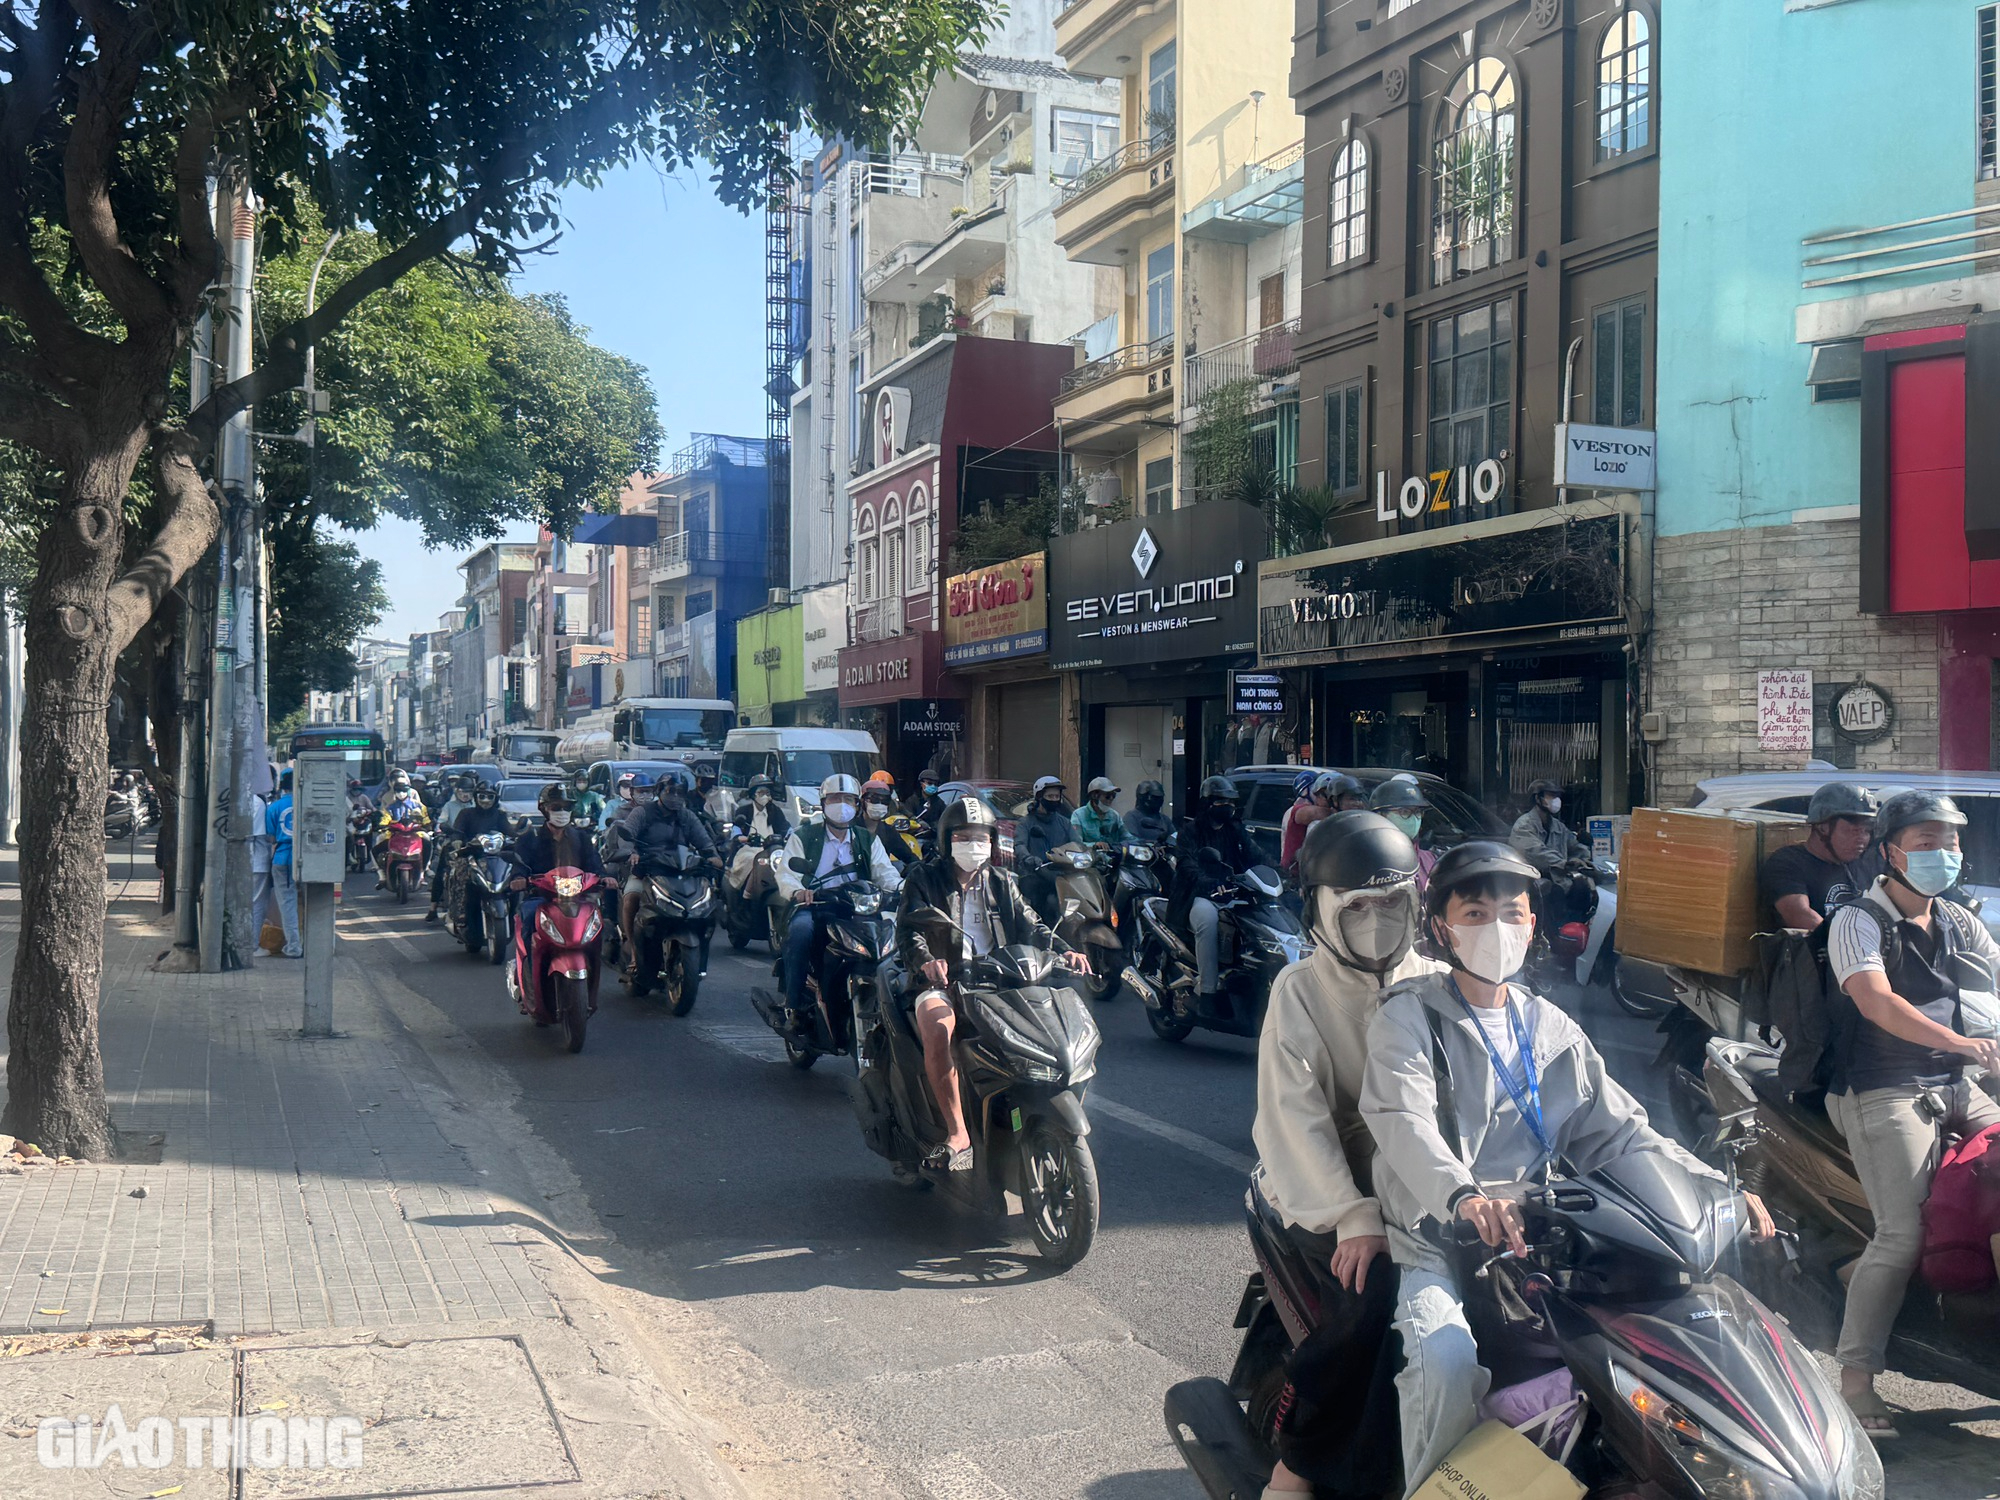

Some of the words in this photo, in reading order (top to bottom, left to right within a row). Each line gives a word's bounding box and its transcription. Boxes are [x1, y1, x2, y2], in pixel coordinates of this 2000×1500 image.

[1571, 439, 1652, 457] VESTON
[1377, 458, 1502, 522] LOZIO
[1020, 563, 1033, 600] 3
[1101, 624, 1132, 637] VESTON
[1134, 624, 1139, 634] &
[1141, 617, 1188, 633] MENSWEAR
[845, 667, 873, 687] ADAM
[877, 657, 908, 681] STORE
[1258, 688, 1279, 697] TRANG
[1789, 687, 1811, 699] Bắc
[1236, 702, 1252, 711] NAM
[1253, 700, 1272, 711] CÔNG
[903, 721, 933, 731] ADAM
[1361, 872, 1404, 886] Andes
[1437, 1461, 1464, 1483] SHOP
